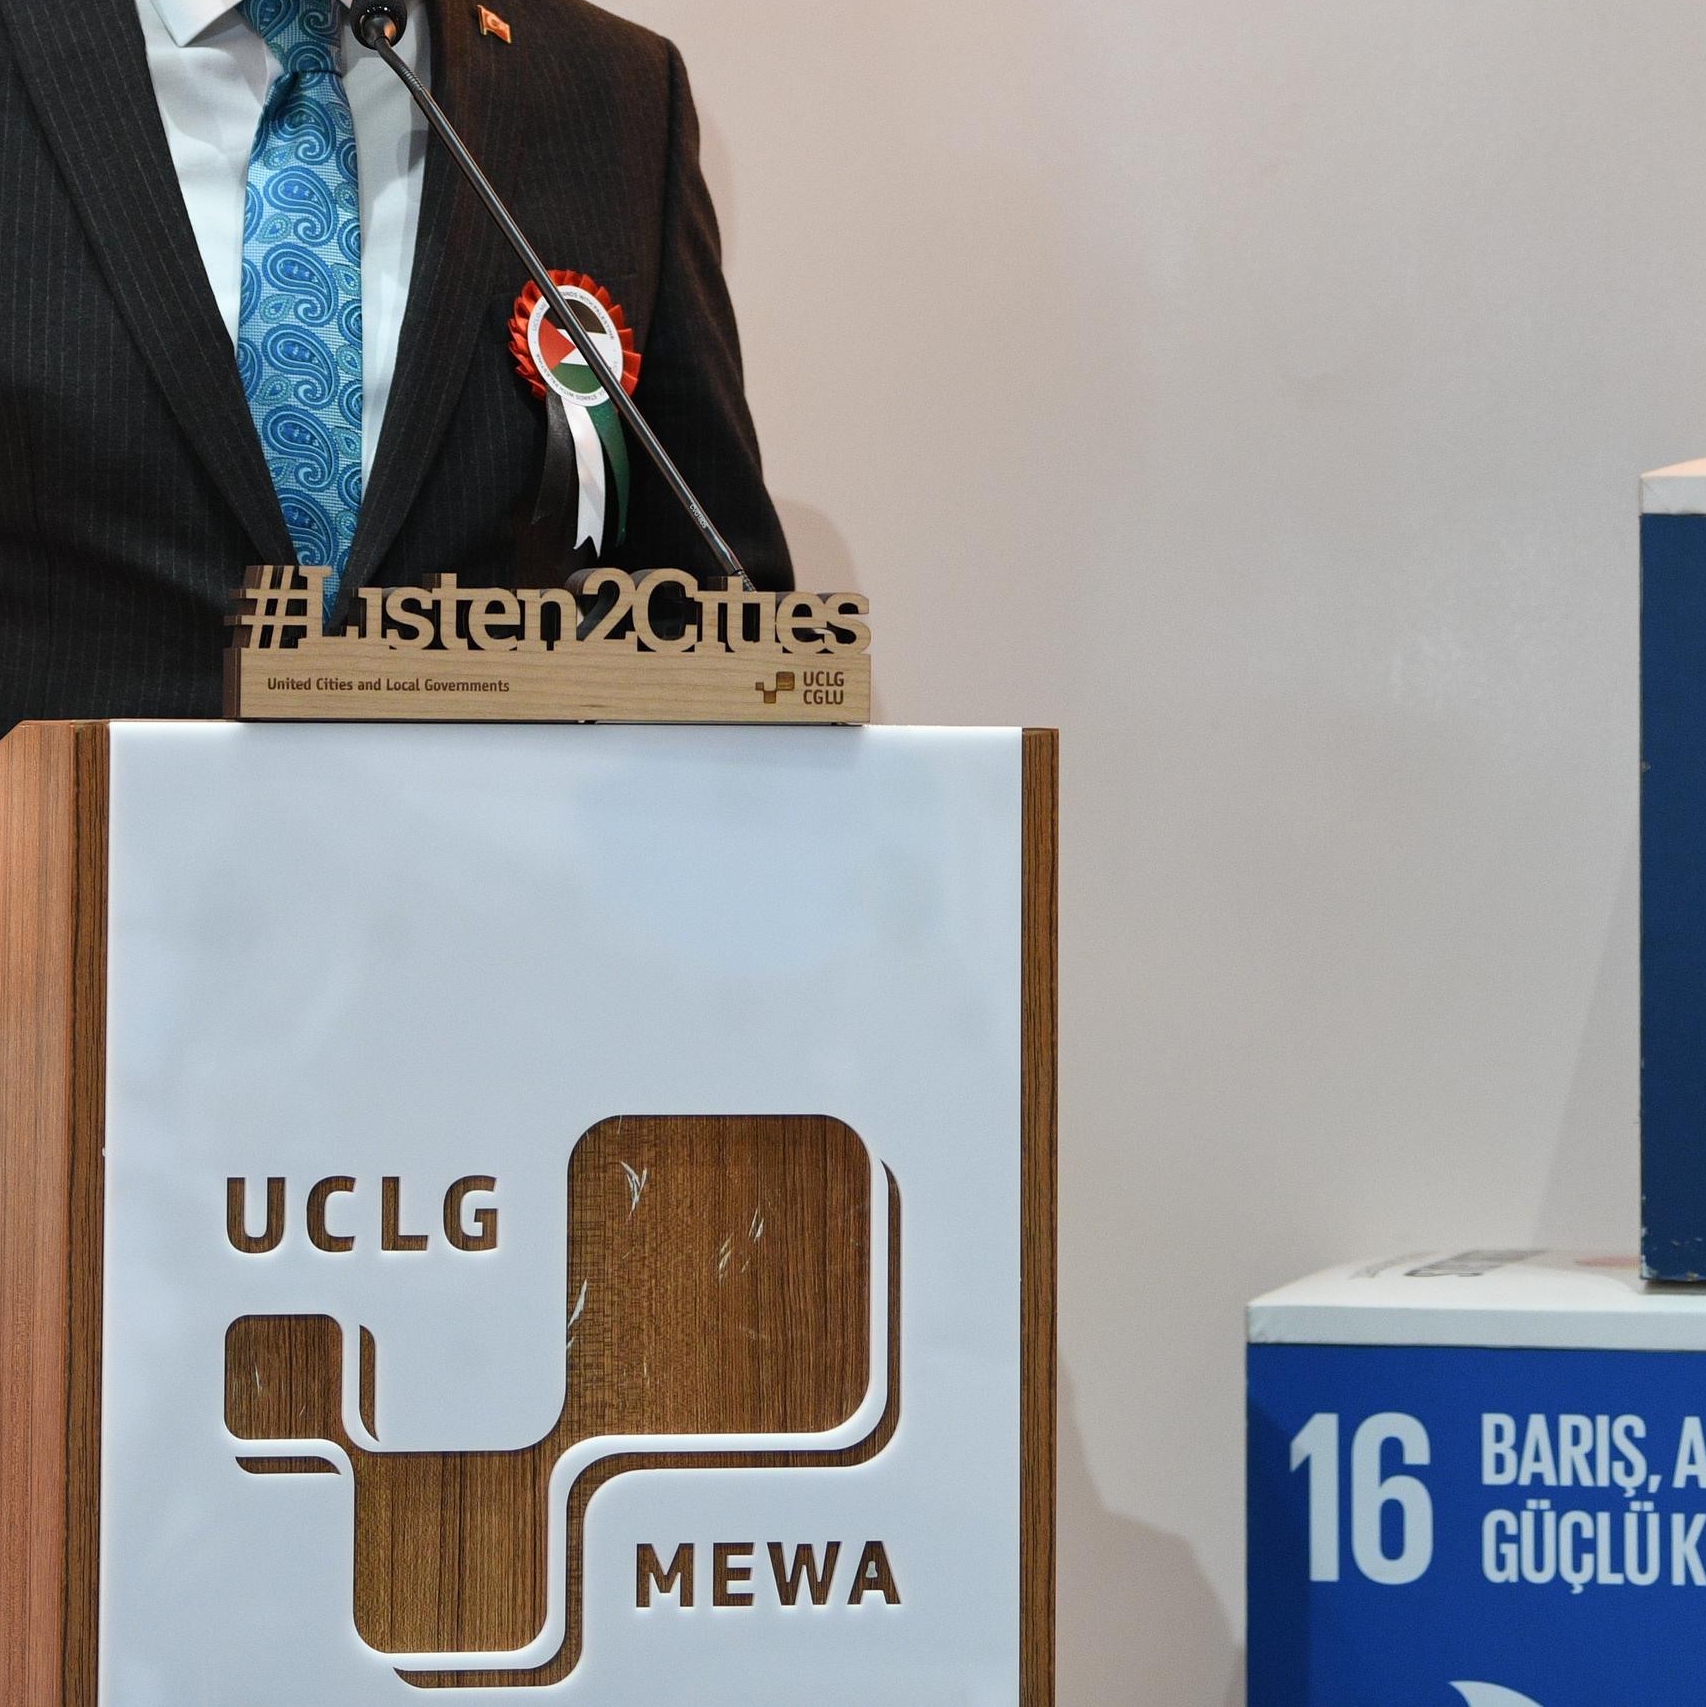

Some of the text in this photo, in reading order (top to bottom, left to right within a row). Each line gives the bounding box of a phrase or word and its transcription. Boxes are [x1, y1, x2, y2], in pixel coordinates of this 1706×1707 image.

[267, 677, 510, 692] United Cities and Local Governments
[803, 671, 844, 687] UCLG
[803, 689, 844, 705] CGLU
[225, 1175, 499, 1254] UCLG
[1481, 1412, 1661, 1499] BARIŞ,
[1290, 1411, 1434, 1585] 16
[635, 1540, 902, 1609] MEWA
[1481, 1499, 1660, 1595] GÜÇLÜ
